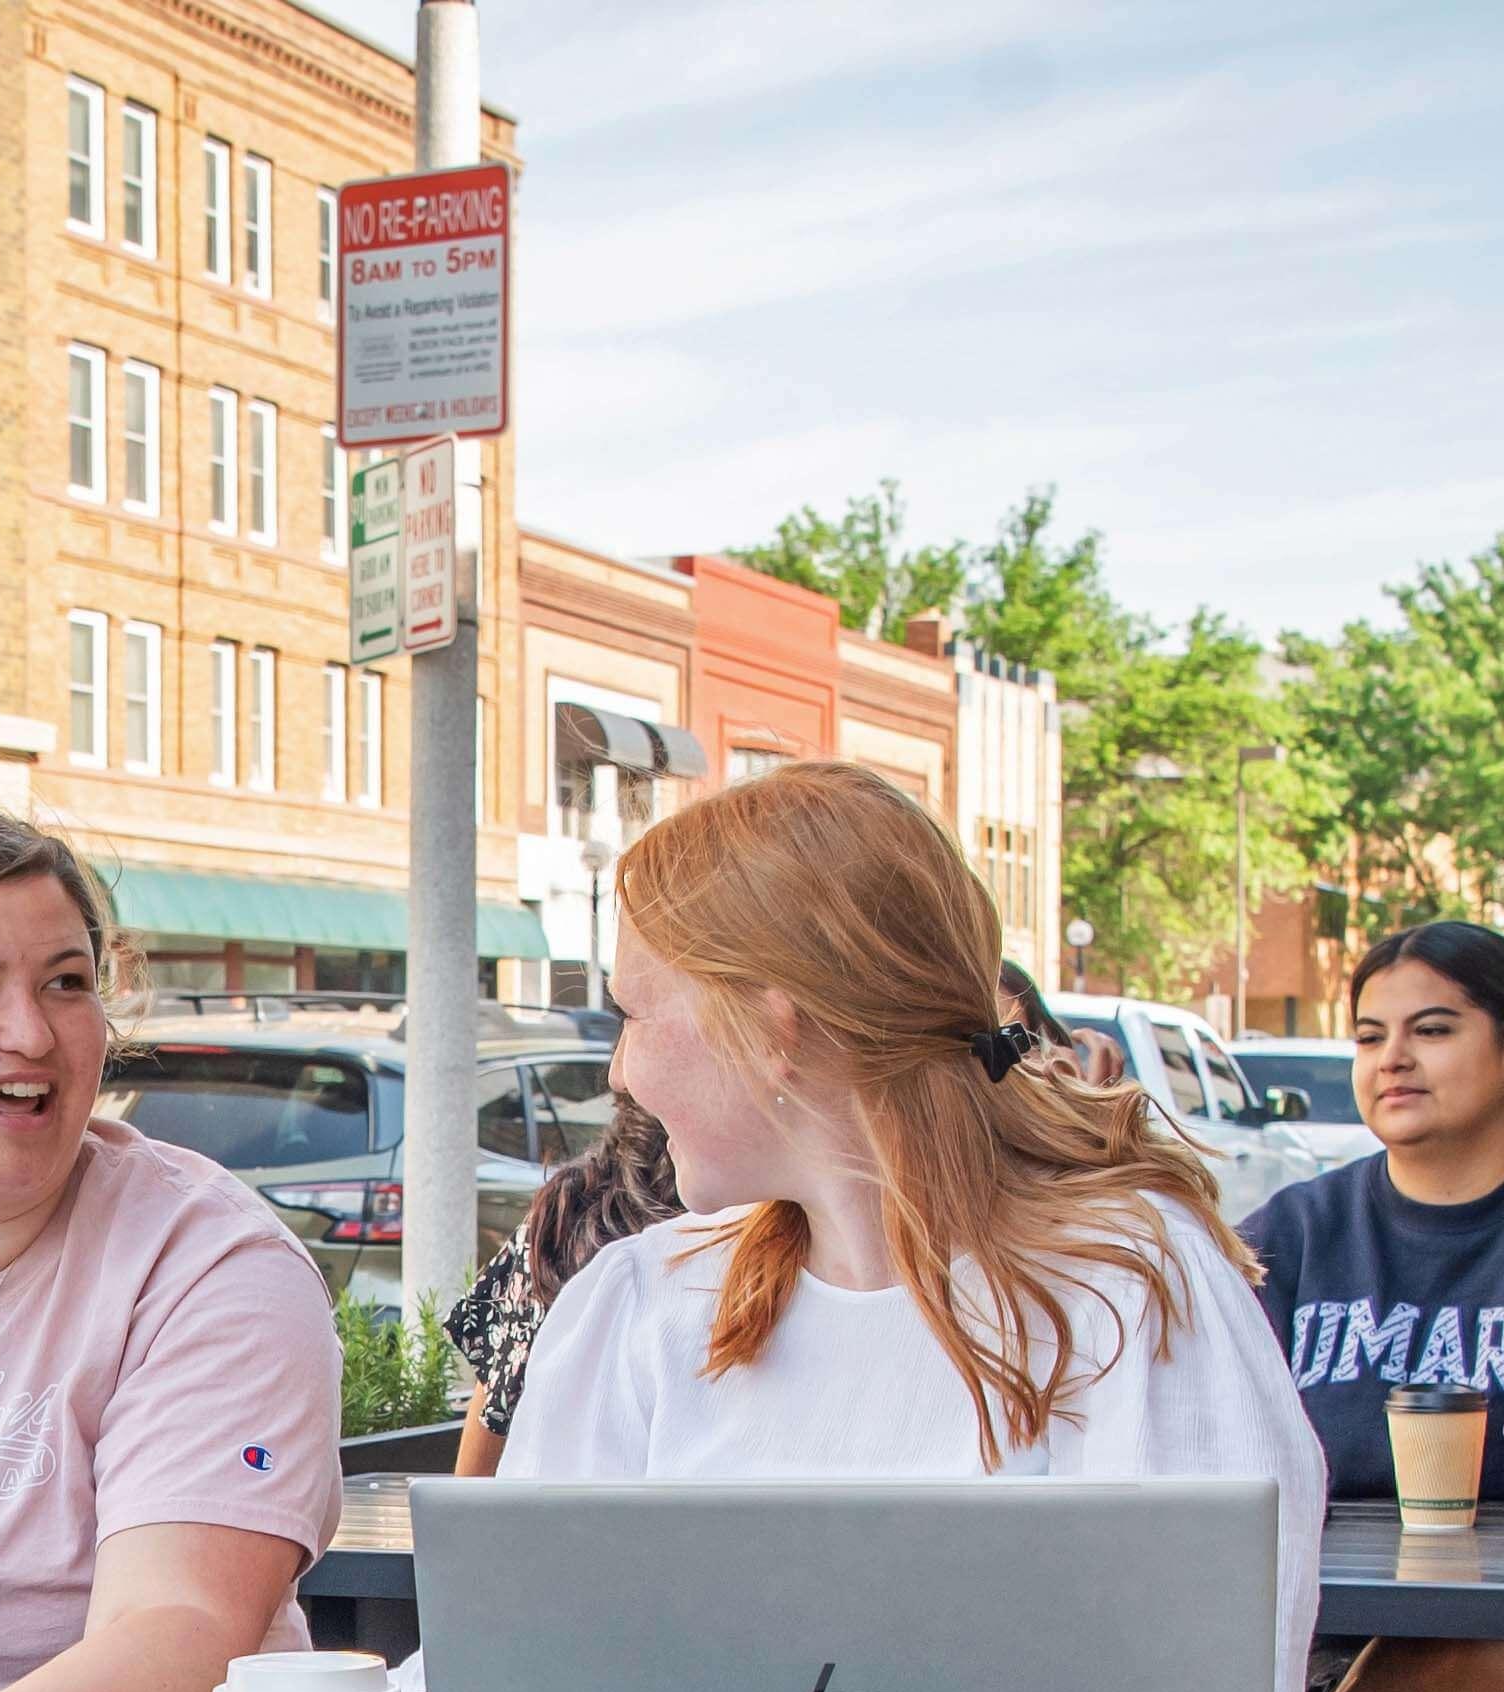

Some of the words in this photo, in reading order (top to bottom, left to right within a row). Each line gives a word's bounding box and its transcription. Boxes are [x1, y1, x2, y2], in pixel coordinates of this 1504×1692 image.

[344, 203, 376, 246] NO
[351, 259, 402, 286] 8AM
[412, 260, 436, 278] TO
[446, 247, 496, 274] 5PM
[419, 459, 437, 497] NO
[405, 500, 451, 546] PARKING
